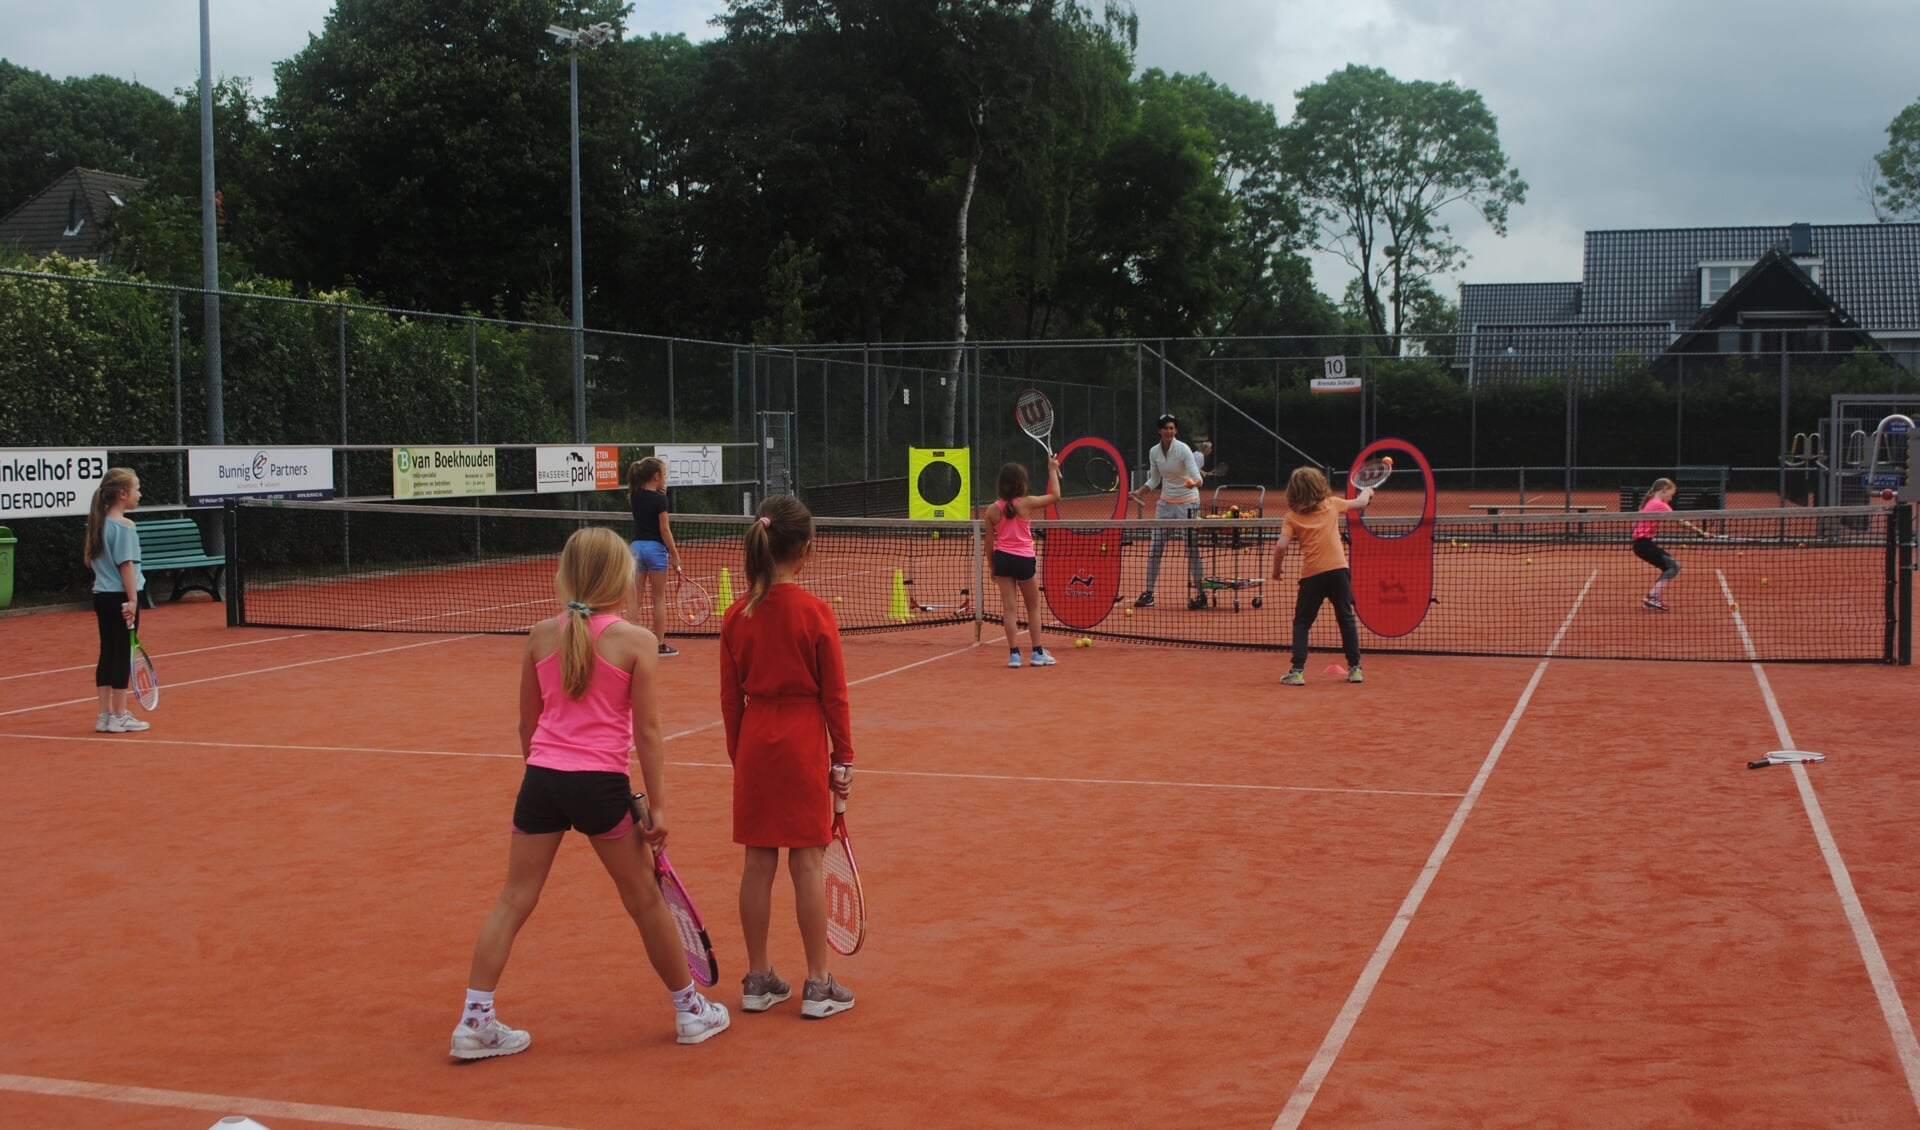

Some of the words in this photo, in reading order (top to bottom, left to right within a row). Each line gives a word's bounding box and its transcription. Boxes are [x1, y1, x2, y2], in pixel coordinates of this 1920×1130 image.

[1326, 359, 1343, 375] 10
[412, 455, 430, 469] van
[434, 450, 494, 468] Boekhouden
[596, 450, 609, 459] ETEN
[78, 457, 103, 480] 83
[218, 463, 251, 482] Bunnig
[270, 463, 308, 477] Partners
[538, 470, 570, 479] BRASSERIE
[571, 461, 594, 487] park
[596, 460, 617, 469] DRINKEN
[1, 491, 76, 510] DERDORP
